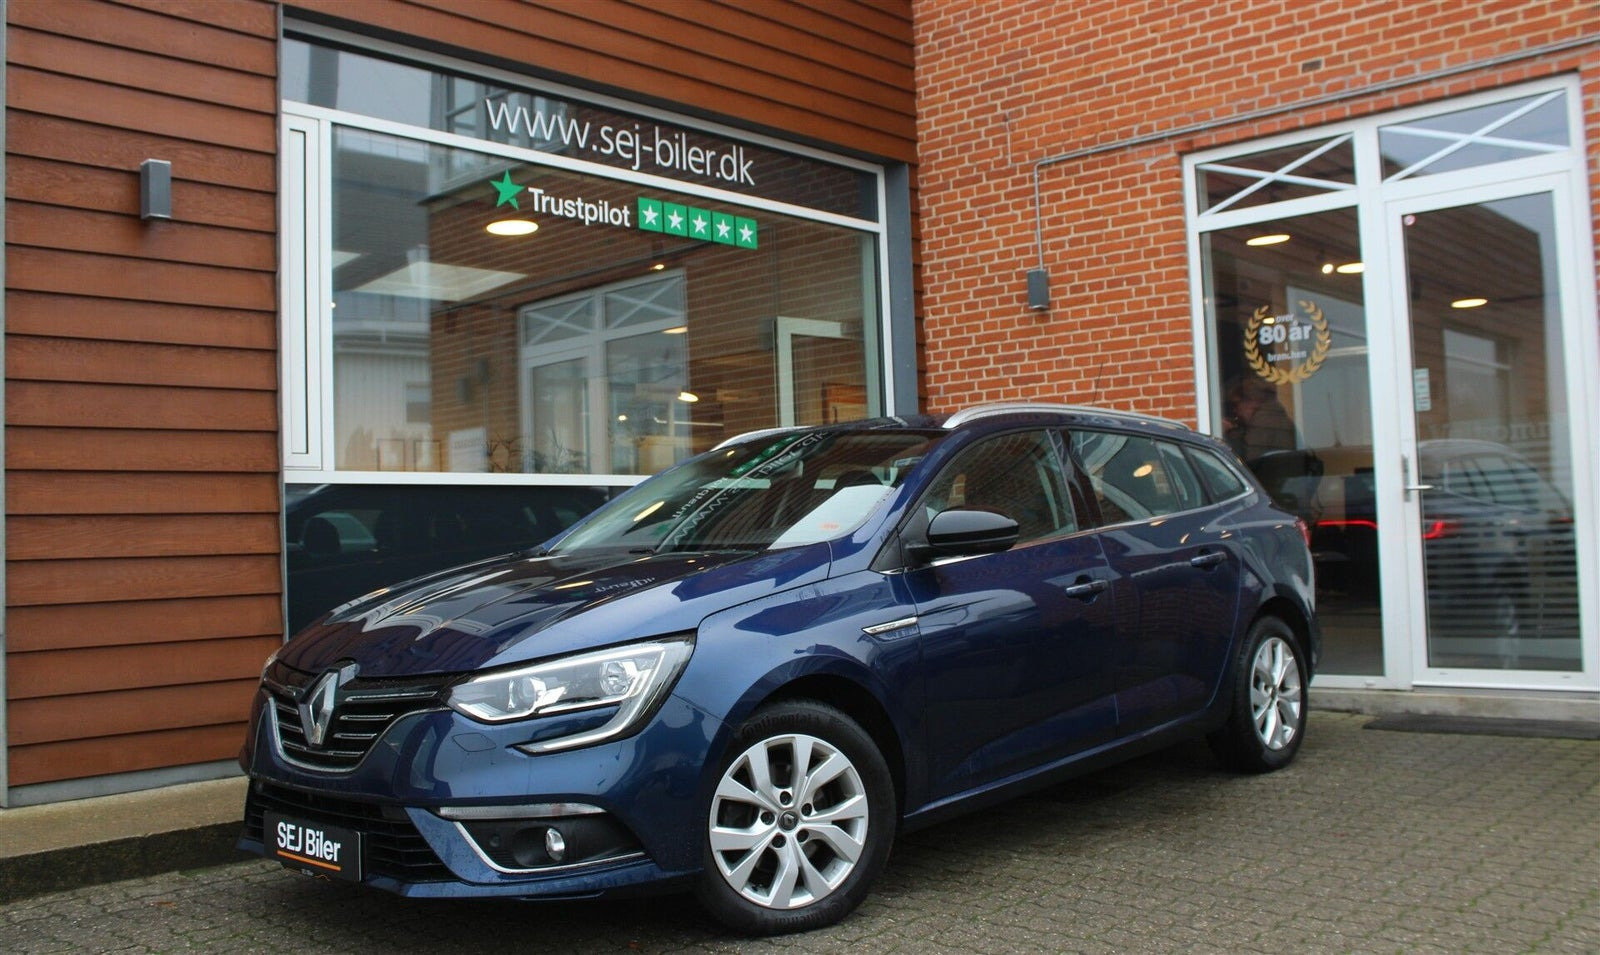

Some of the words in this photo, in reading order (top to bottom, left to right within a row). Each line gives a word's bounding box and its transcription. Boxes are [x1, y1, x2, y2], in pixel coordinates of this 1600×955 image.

[486, 98, 755, 186] www.sej-biler.dk
[528, 187, 631, 228] Trustpilot
[1259, 324, 1286, 345] 80
[1289, 320, 1312, 340] år
[277, 821, 303, 852] SEJ
[305, 828, 341, 862] Biler
